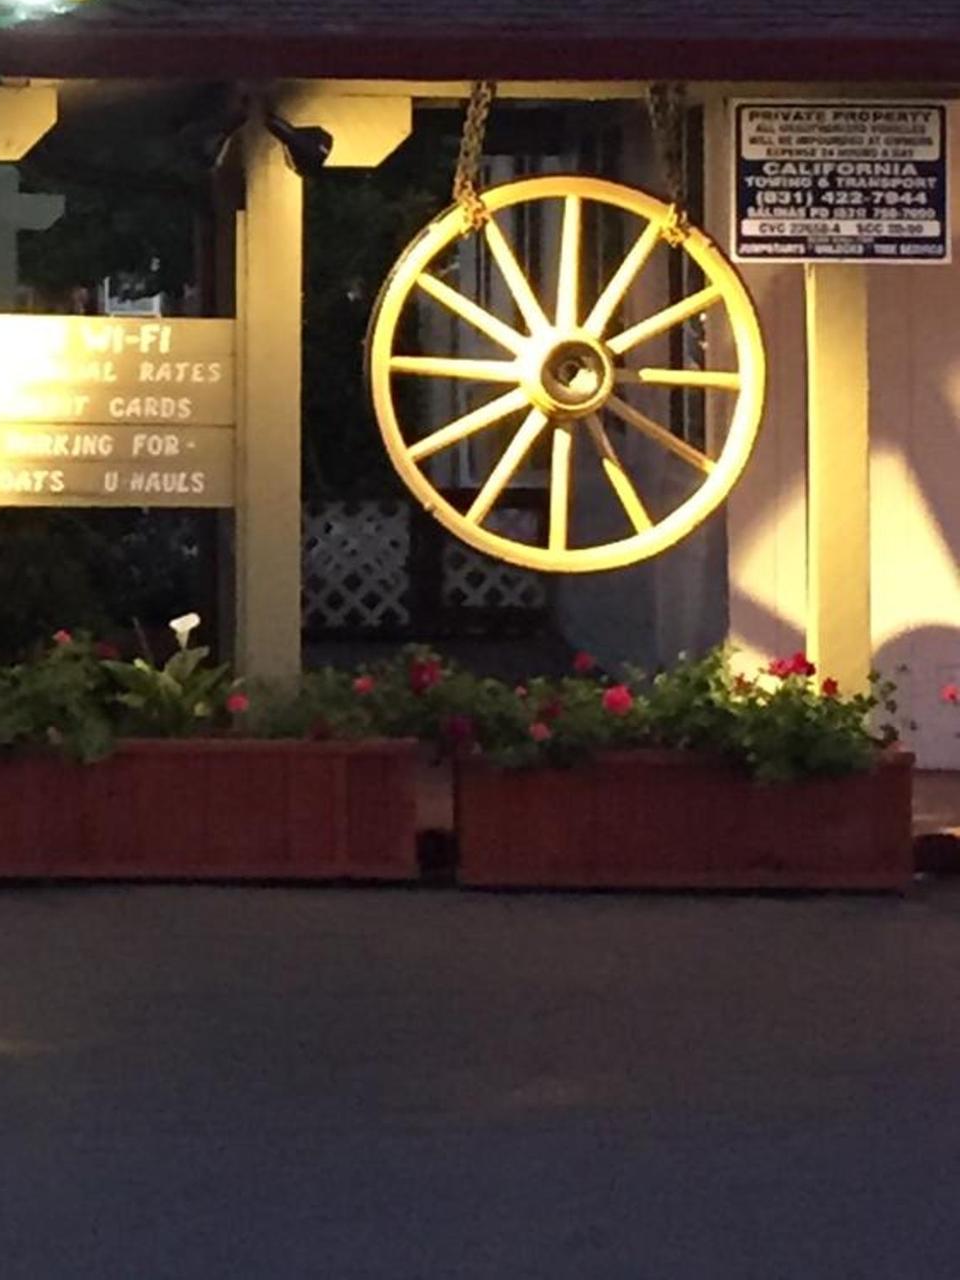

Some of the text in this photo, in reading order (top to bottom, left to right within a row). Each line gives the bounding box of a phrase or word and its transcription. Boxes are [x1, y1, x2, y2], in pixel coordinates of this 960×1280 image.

[748, 111, 932, 123] PRIVATE PROPERTY
[762, 163, 918, 175] CALIFORNIA
[745, 177, 812, 189] TOWING
[836, 177, 937, 189] TRANSPORT
[140, 363, 222, 383] RATES
[109, 397, 192, 418] CARDS
[6, 433, 114, 456] RKING
